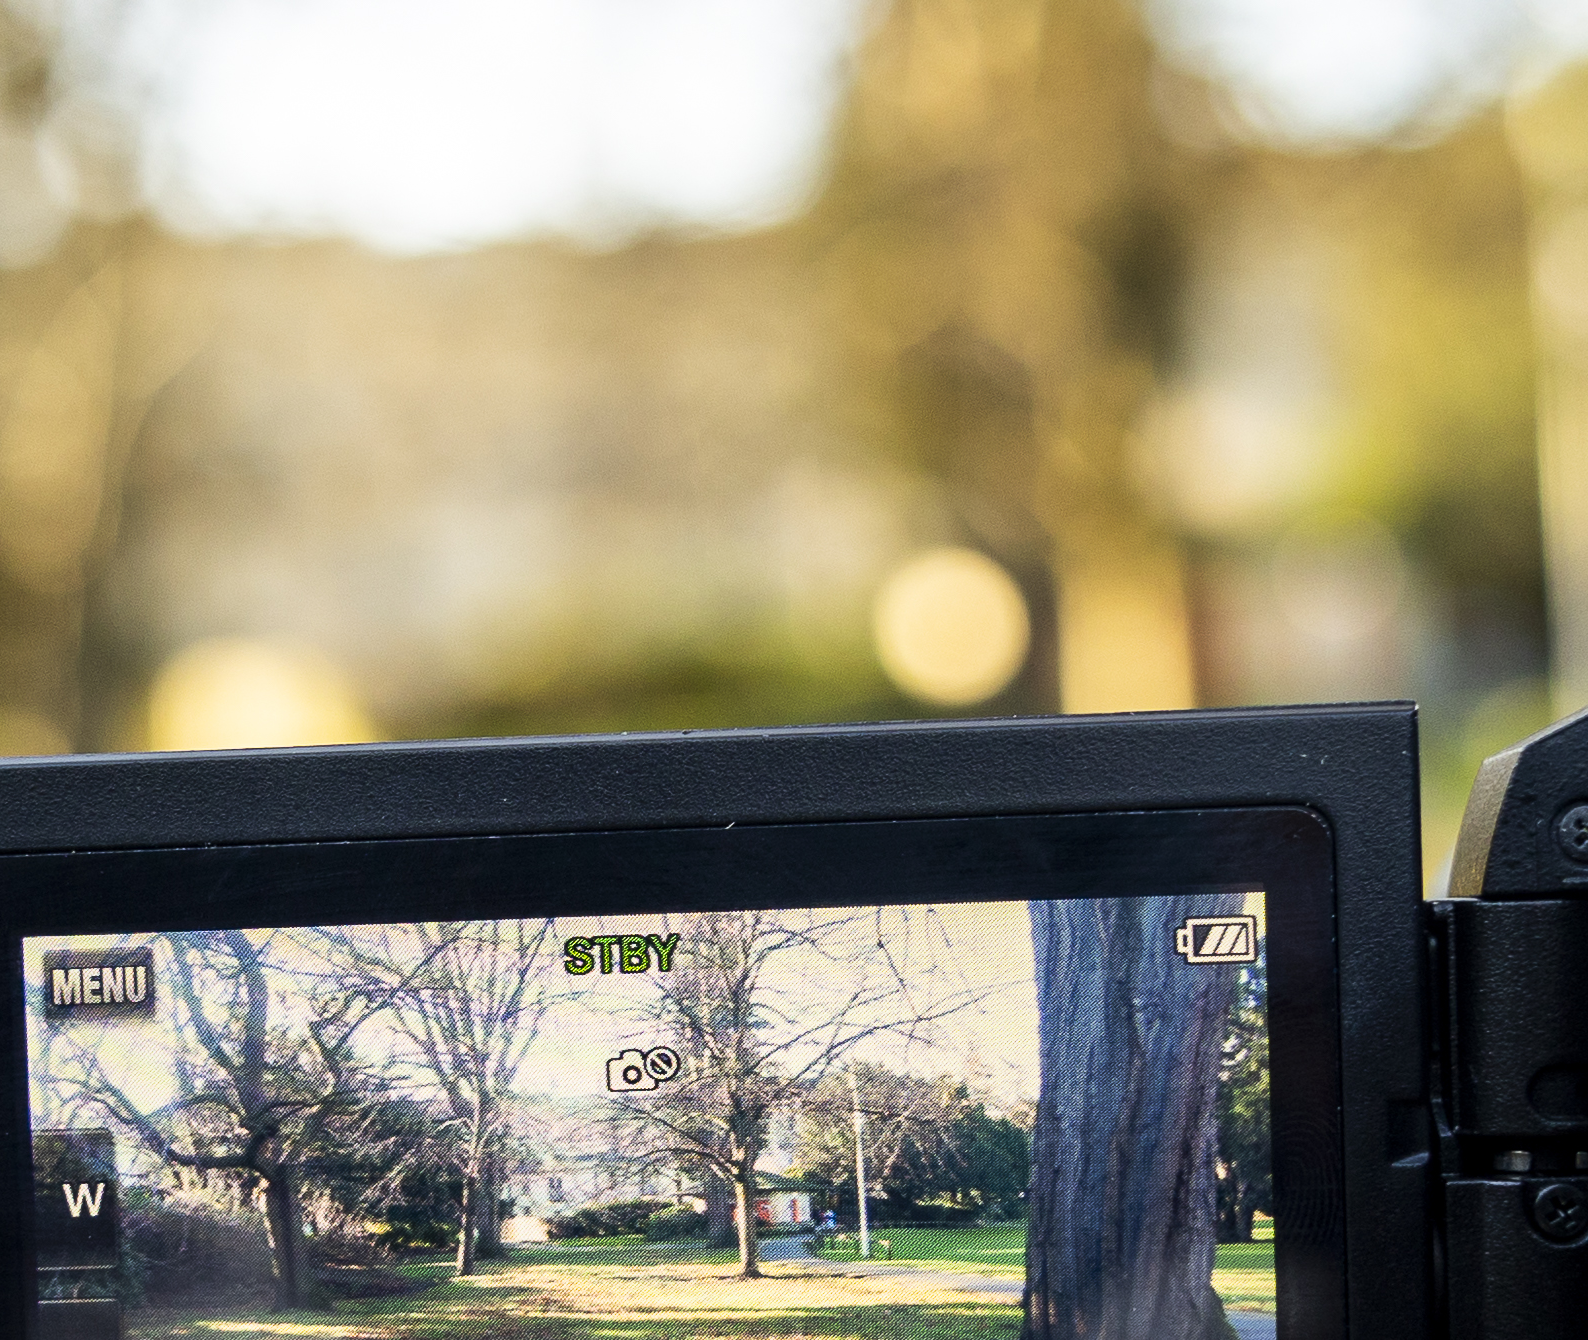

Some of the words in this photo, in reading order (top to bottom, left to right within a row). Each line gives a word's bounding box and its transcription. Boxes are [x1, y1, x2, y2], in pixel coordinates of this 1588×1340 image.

[563, 933, 680, 974] STBY
[51, 965, 147, 1006] MENU
[63, 1182, 105, 1218] W
